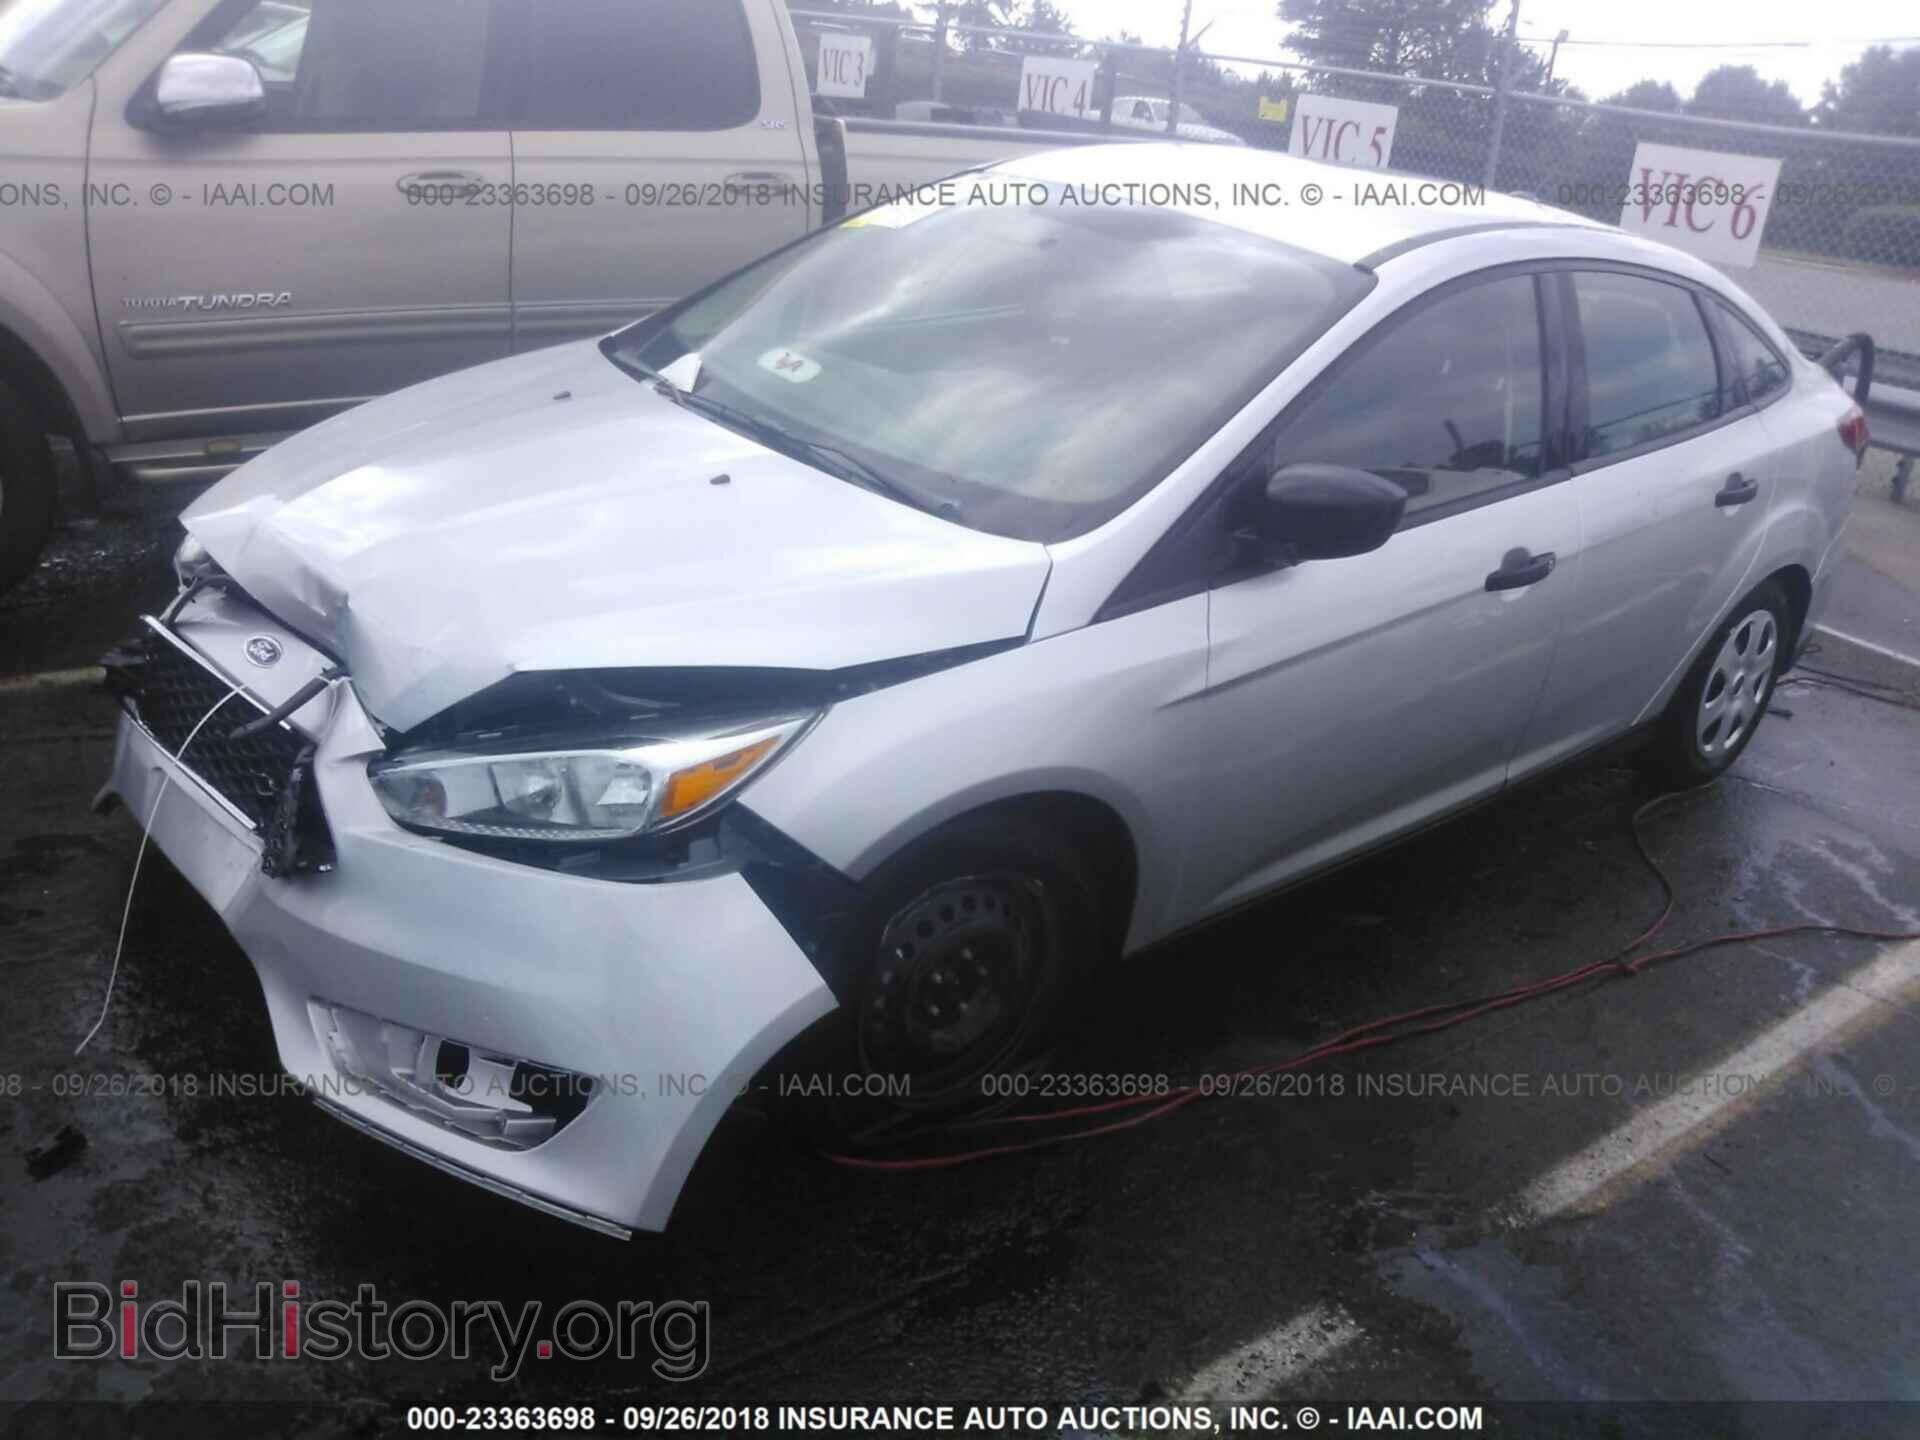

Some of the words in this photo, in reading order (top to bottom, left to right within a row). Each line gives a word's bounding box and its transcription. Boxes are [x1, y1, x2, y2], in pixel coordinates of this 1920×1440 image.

[822, 49, 850, 85] VIC
[853, 51, 865, 88] 3
[1025, 73, 1068, 114] VIC
[1072, 79, 1086, 118] 4
[1301, 115, 1361, 162] VIC
[1369, 126, 1389, 167] 5
[1640, 167, 1724, 234] VIC
[1731, 183, 1765, 241] 6
[177, 291, 292, 311] TUNDRA
